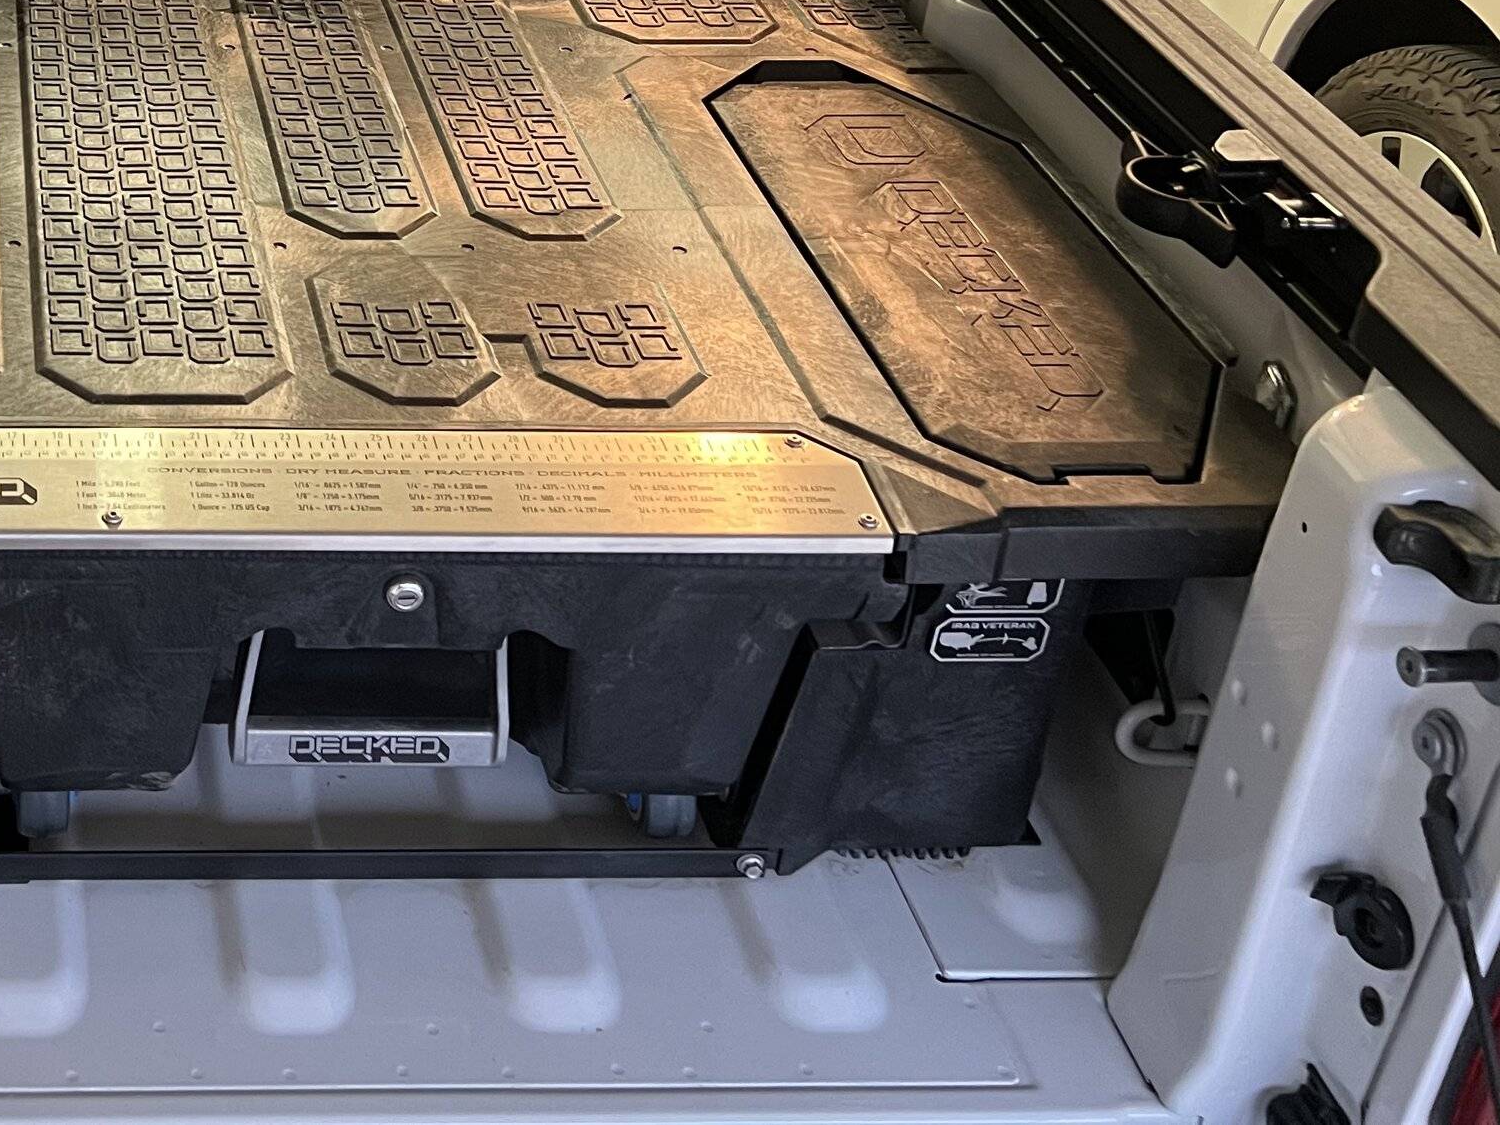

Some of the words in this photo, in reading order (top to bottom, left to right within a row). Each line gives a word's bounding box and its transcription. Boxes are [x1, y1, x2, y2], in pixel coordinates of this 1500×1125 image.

[235, 432, 245, 440] 22
[462, 434, 472, 442] 27
[982, 622, 1036, 630] VETERAN
[288, 734, 450, 764] DECKED
